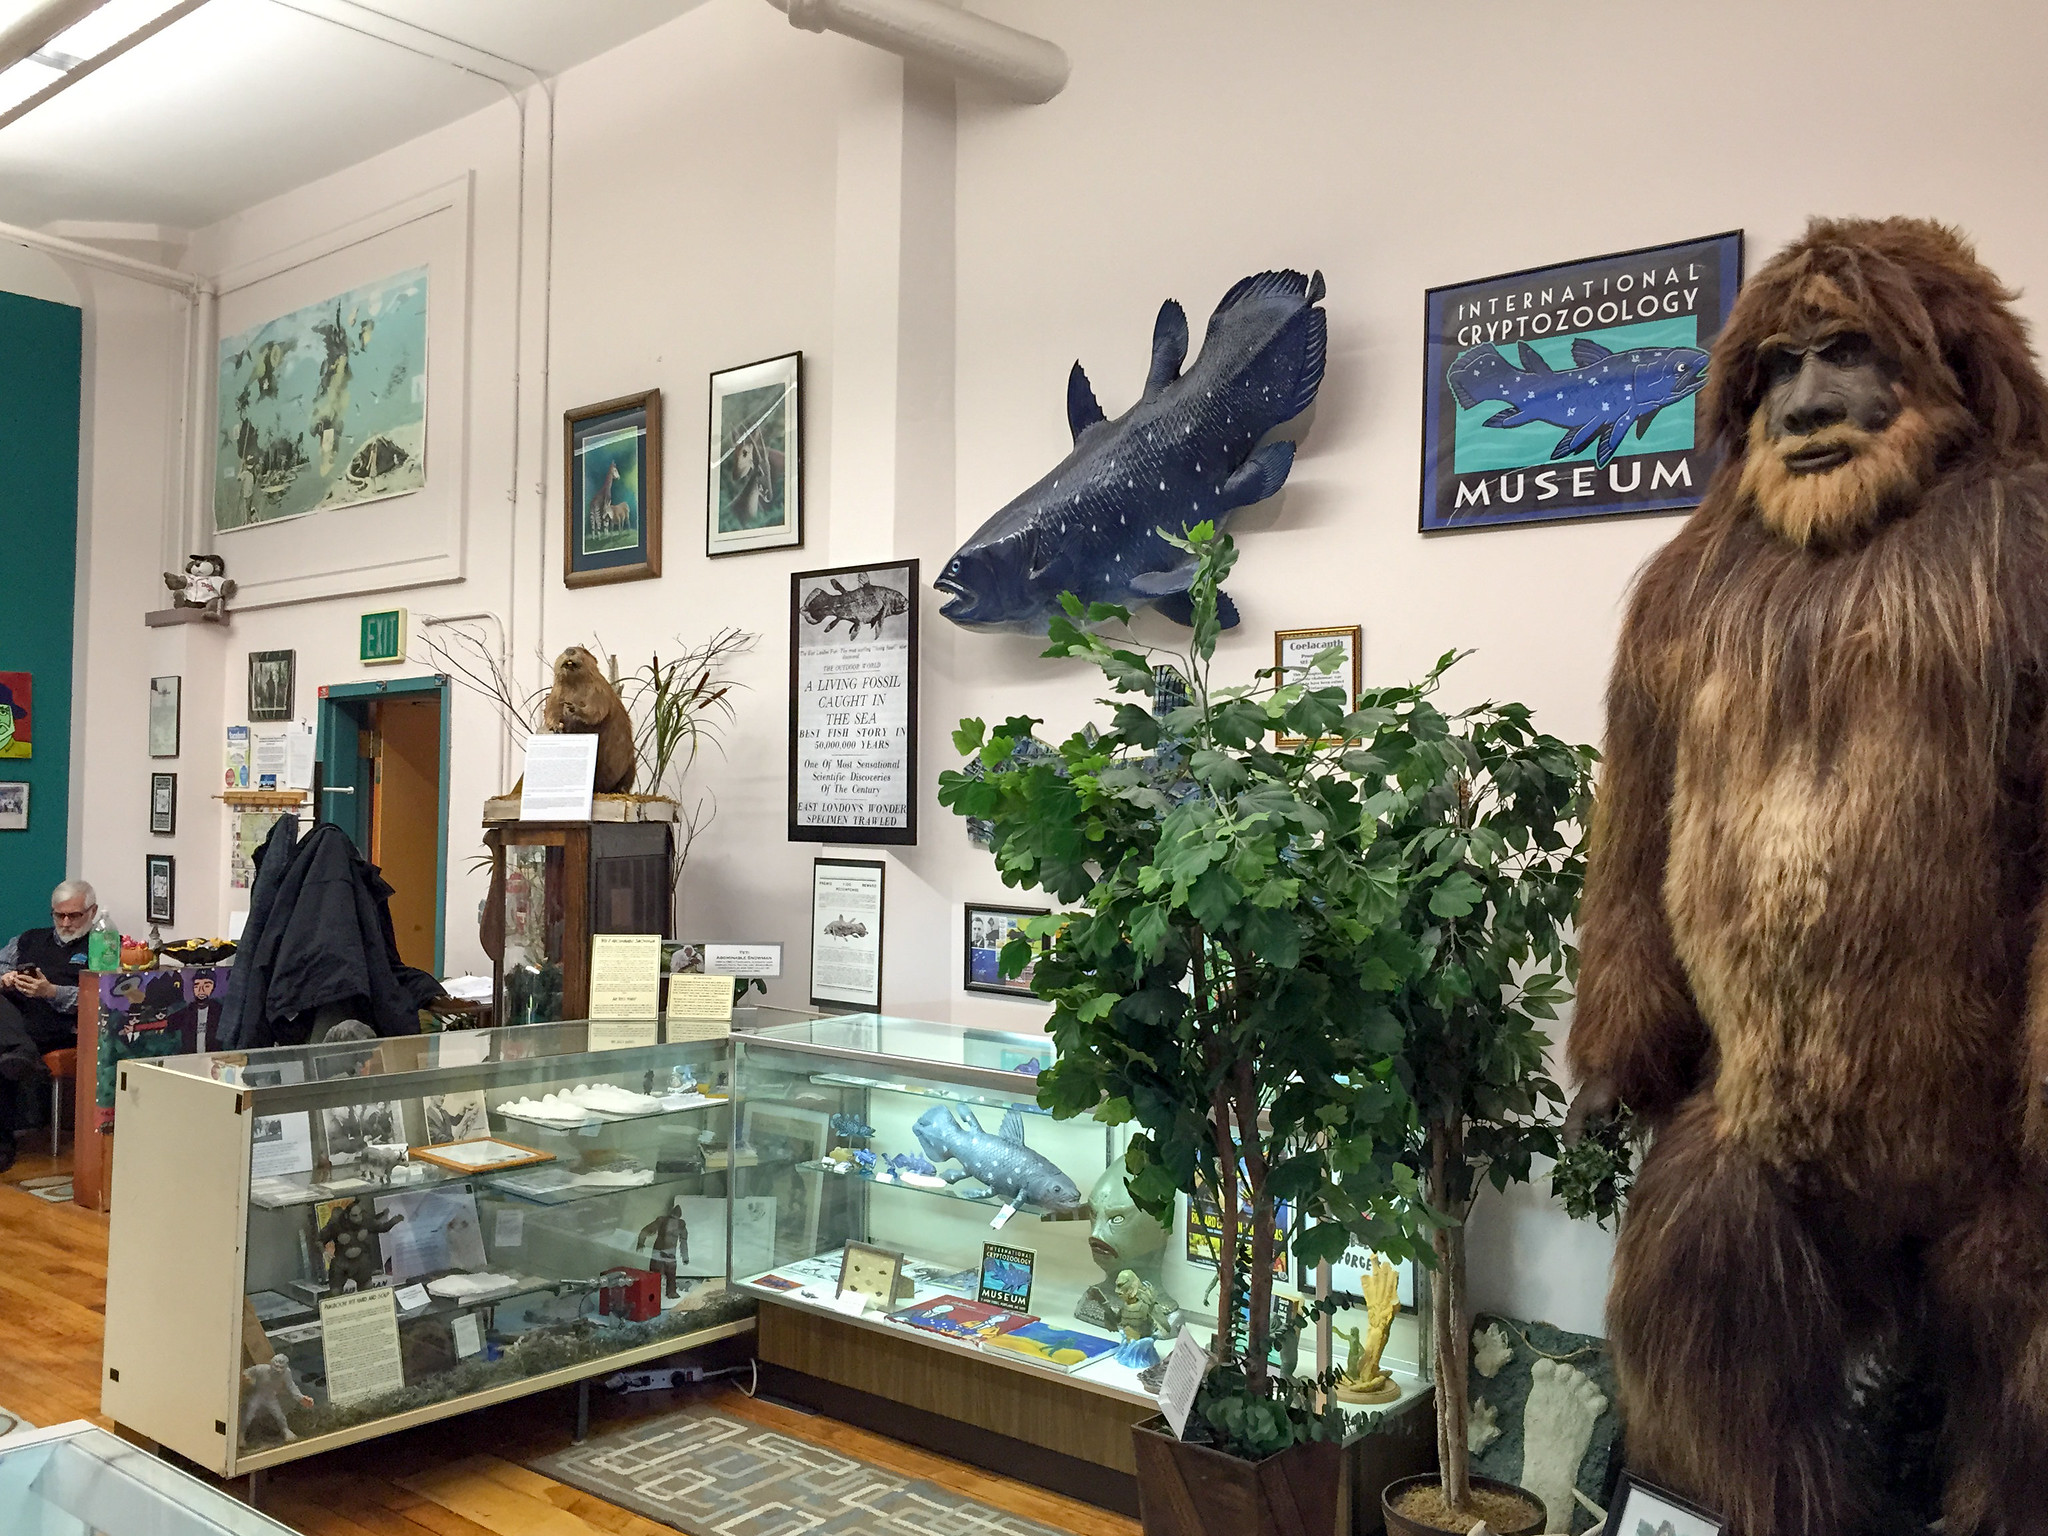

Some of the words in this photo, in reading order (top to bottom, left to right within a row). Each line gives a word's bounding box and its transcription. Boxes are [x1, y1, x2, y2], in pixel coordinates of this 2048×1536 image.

[1458, 263, 1699, 321] INTERNATIONAL
[1457, 288, 1699, 346] CRYPTOZOOLOGY
[1454, 457, 1693, 508] MUSEUM
[367, 616, 396, 657] EXIT
[1290, 639, 1343, 650] Coelacanth
[804, 681, 812, 692] A
[817, 678, 857, 691] LIVING
[862, 675, 901, 688] FOSSIL
[818, 694, 868, 708] CAUGHT
[872, 693, 886, 706] IN
[826, 713, 850, 725] THE
[854, 712, 876, 725] SEA
[799, 729, 820, 738] BEST
[828, 728, 849, 737] FISH
[856, 727, 888, 737] STORY
[895, 727, 906, 737] IN
[815, 741, 856, 750] 50,000,000
[861, 740, 890, 749] YEARS
[804, 759, 818, 769] One
[822, 759, 832, 771] Of
[836, 759, 852, 769] Most
[856, 759, 900, 769] Sensational
[812, 772, 846, 783] Scientific
[850, 772, 891, 781] Discoveries
[821, 785, 831, 796] Of
[834, 785, 847, 793] The
[852, 785, 880, 797] Century
[797, 802, 818, 811] EAST
[822, 803, 863, 813] LONDON'S
[868, 804, 907, 814] WONDER
[806, 815, 848, 825] SPECIMEN
[853, 816, 897, 826] TRAWLED
[982, 1289, 1026, 1305] MUSEUM
